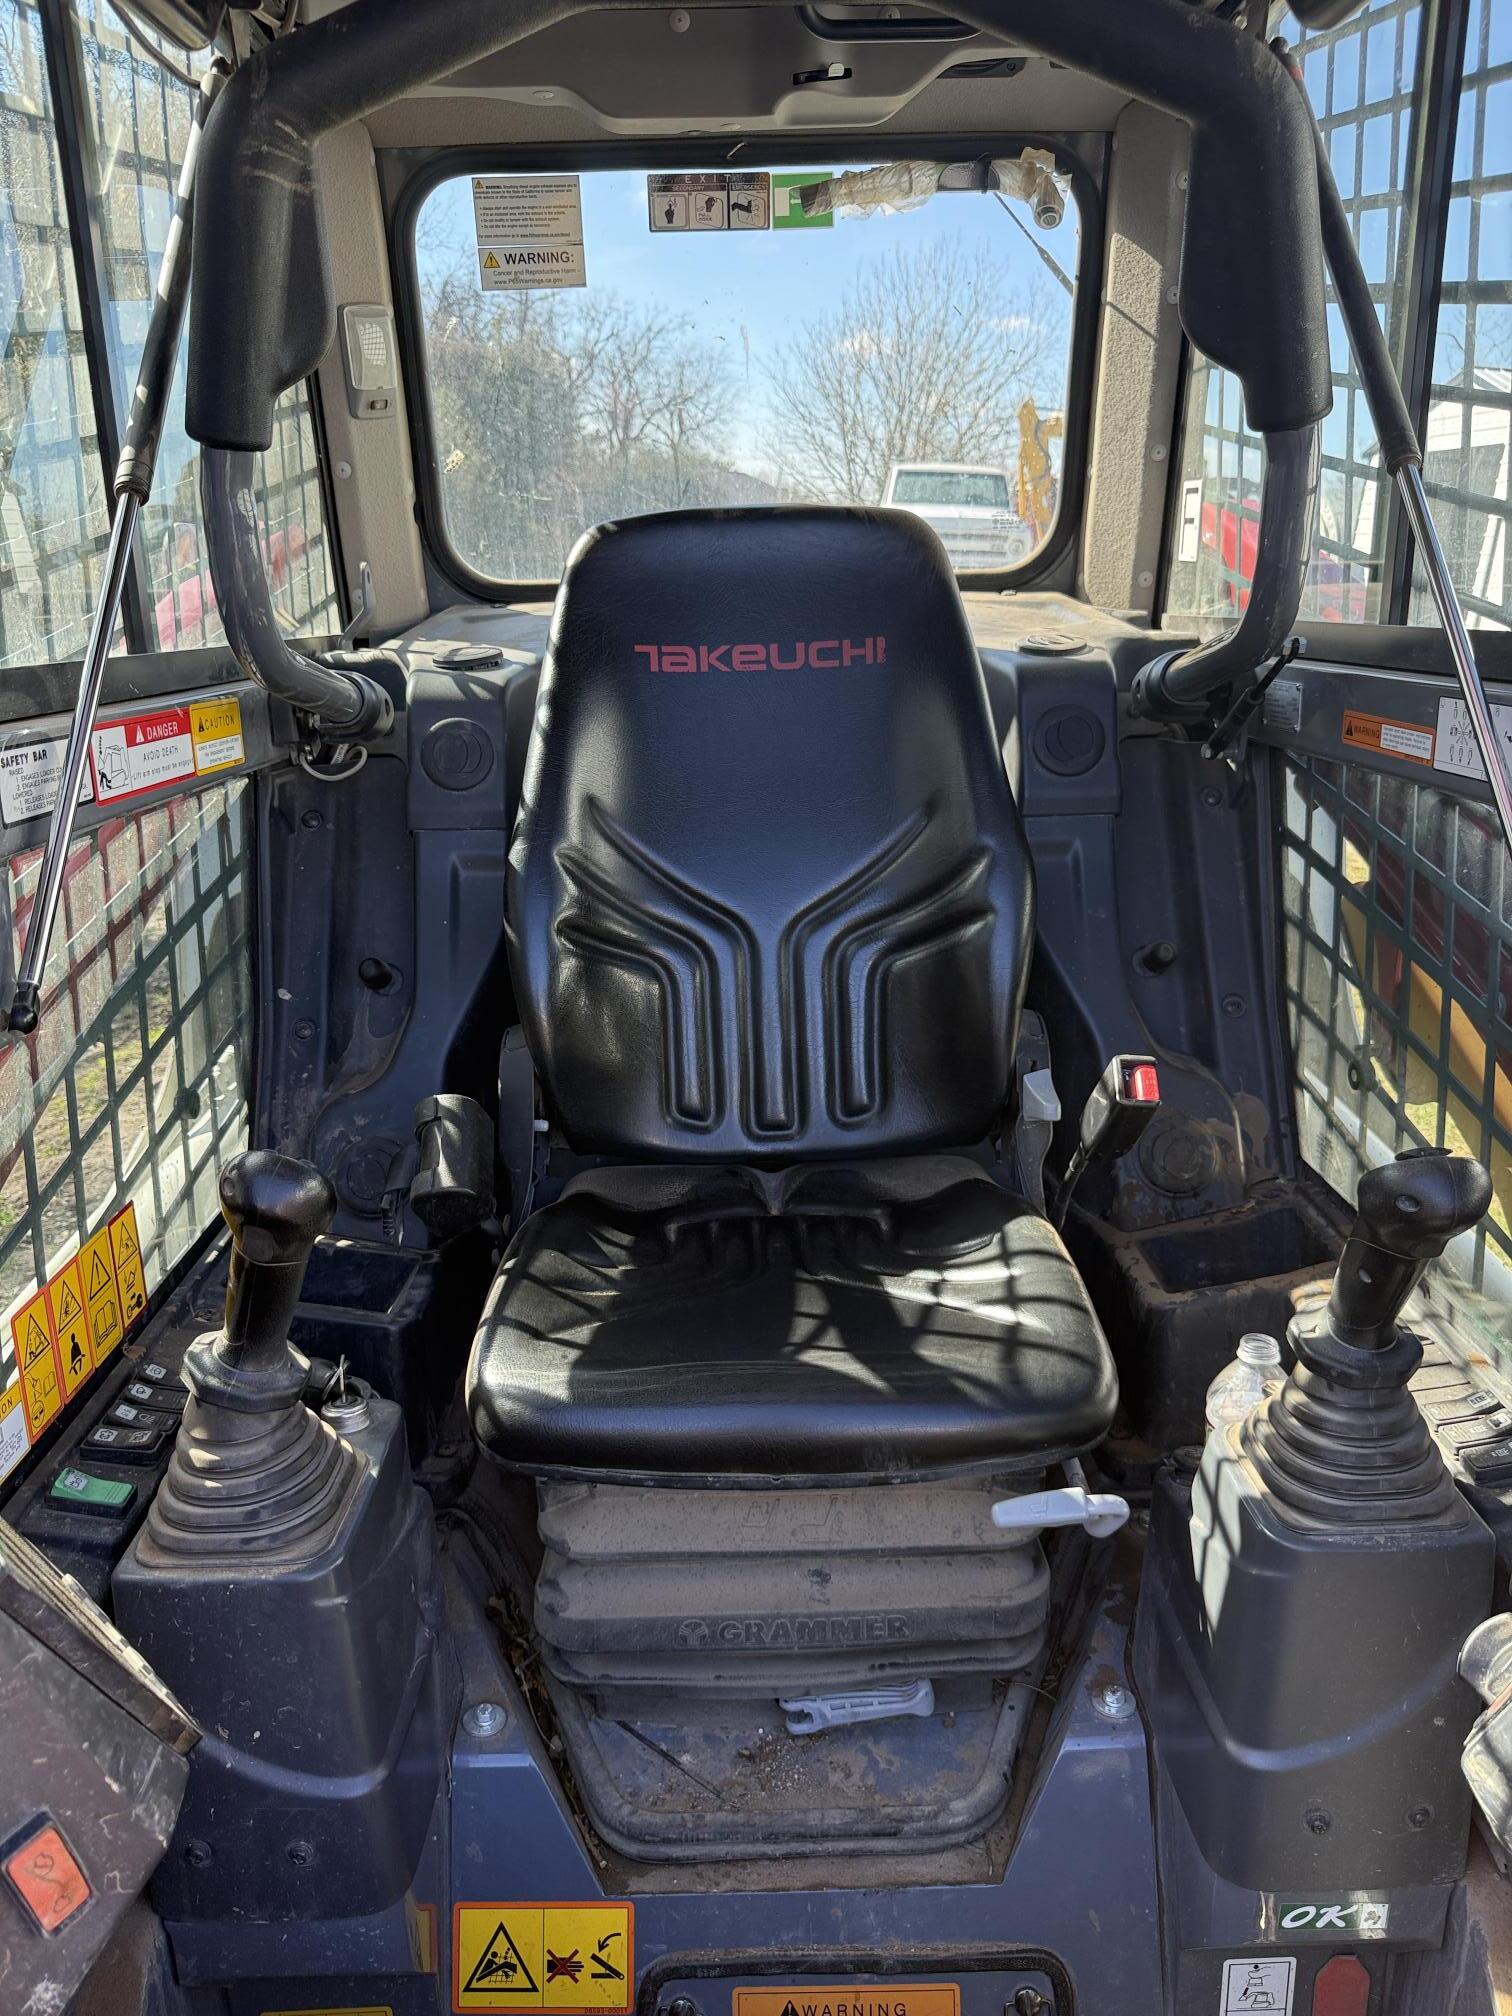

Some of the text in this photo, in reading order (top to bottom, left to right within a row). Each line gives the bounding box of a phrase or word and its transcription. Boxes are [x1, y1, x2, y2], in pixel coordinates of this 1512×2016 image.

[685, 174, 731, 184] EXIT
[504, 251, 575, 265] WARNING:
[147, 721, 179, 741] DANGER
[205, 714, 236, 731] CAUTION
[1354, 724, 1380, 739] WARNING
[0, 749, 48, 769] SAFETY BAR
[143, 744, 179, 762] AVOID DEATH
[718, 1615, 910, 1644] GRAMMER
[1281, 1904, 1358, 1929] OK
[802, 2003, 907, 2016] WARNING
